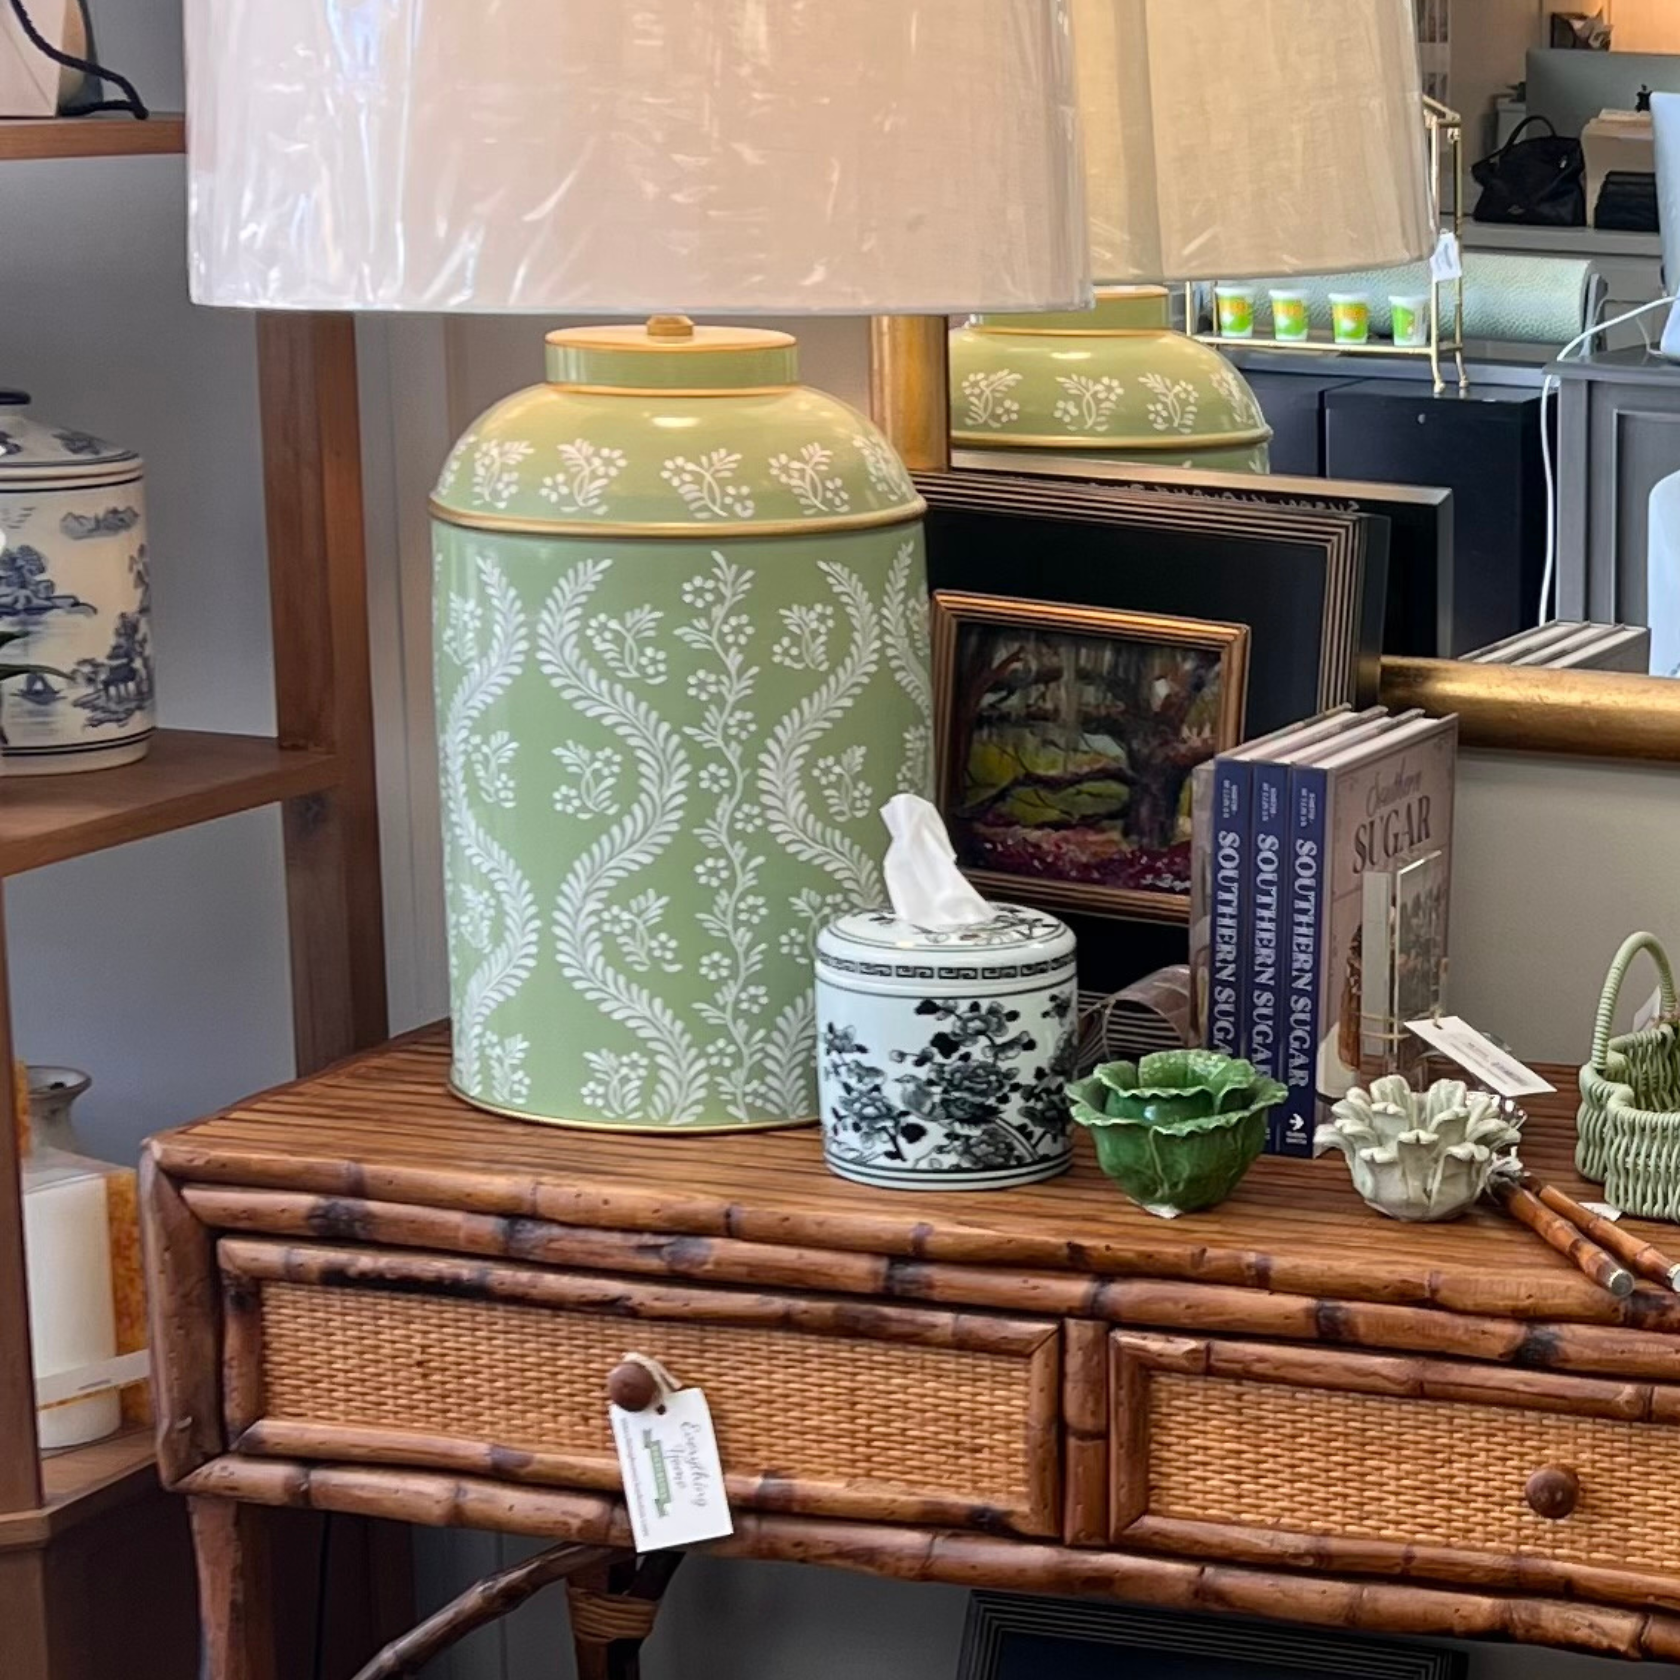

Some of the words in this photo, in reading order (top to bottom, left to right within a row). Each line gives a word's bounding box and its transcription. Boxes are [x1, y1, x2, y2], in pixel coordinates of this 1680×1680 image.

[1352, 795, 1431, 875] SUGAR
[1214, 830, 1241, 982] SOUTHERN
[1253, 833, 1279, 986] SOUTHERN
[1291, 838, 1318, 992] SOUTHERN
[1212, 985, 1237, 1055] SUGA
[1288, 994, 1313, 1088] SUGAR
